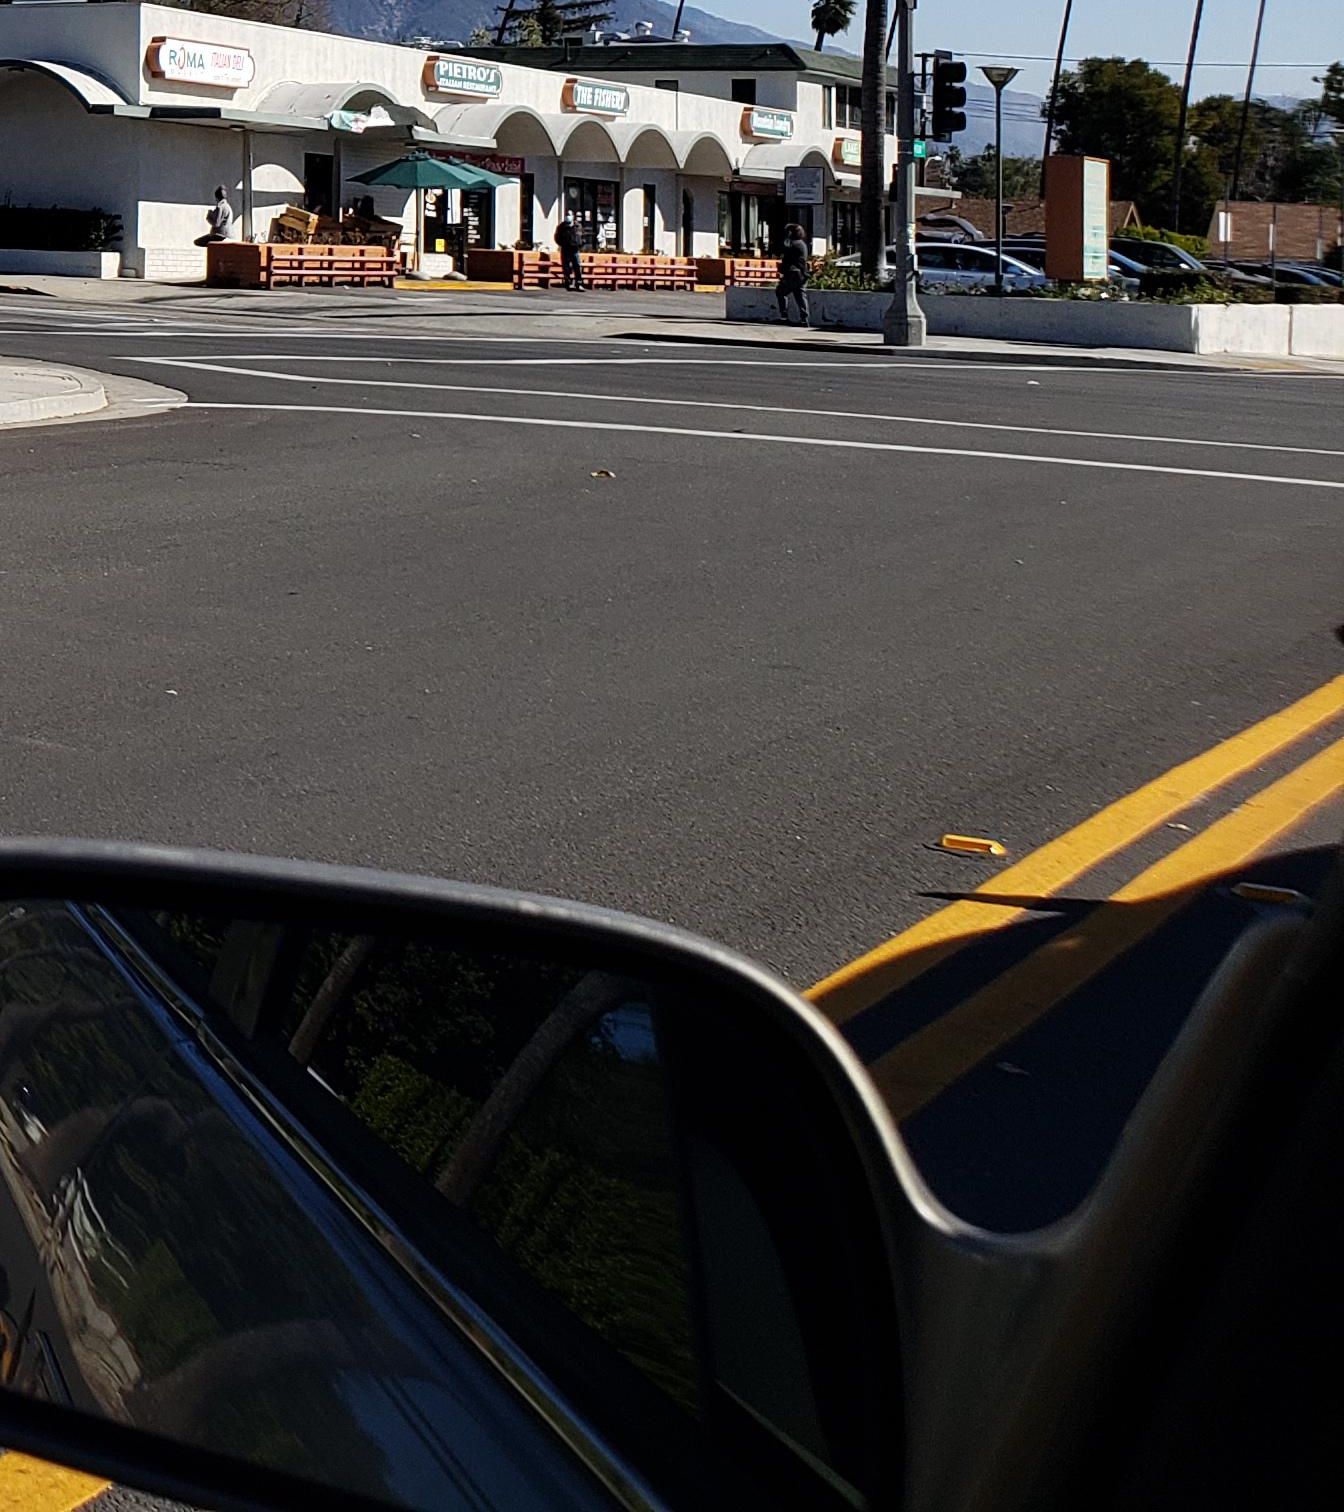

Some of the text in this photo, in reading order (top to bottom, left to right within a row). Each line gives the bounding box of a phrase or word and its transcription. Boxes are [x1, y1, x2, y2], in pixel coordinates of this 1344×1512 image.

[168, 46, 205, 70] ROMA
[439, 61, 497, 83] PIETRO'S
[577, 85, 626, 110] THE FISHERY
